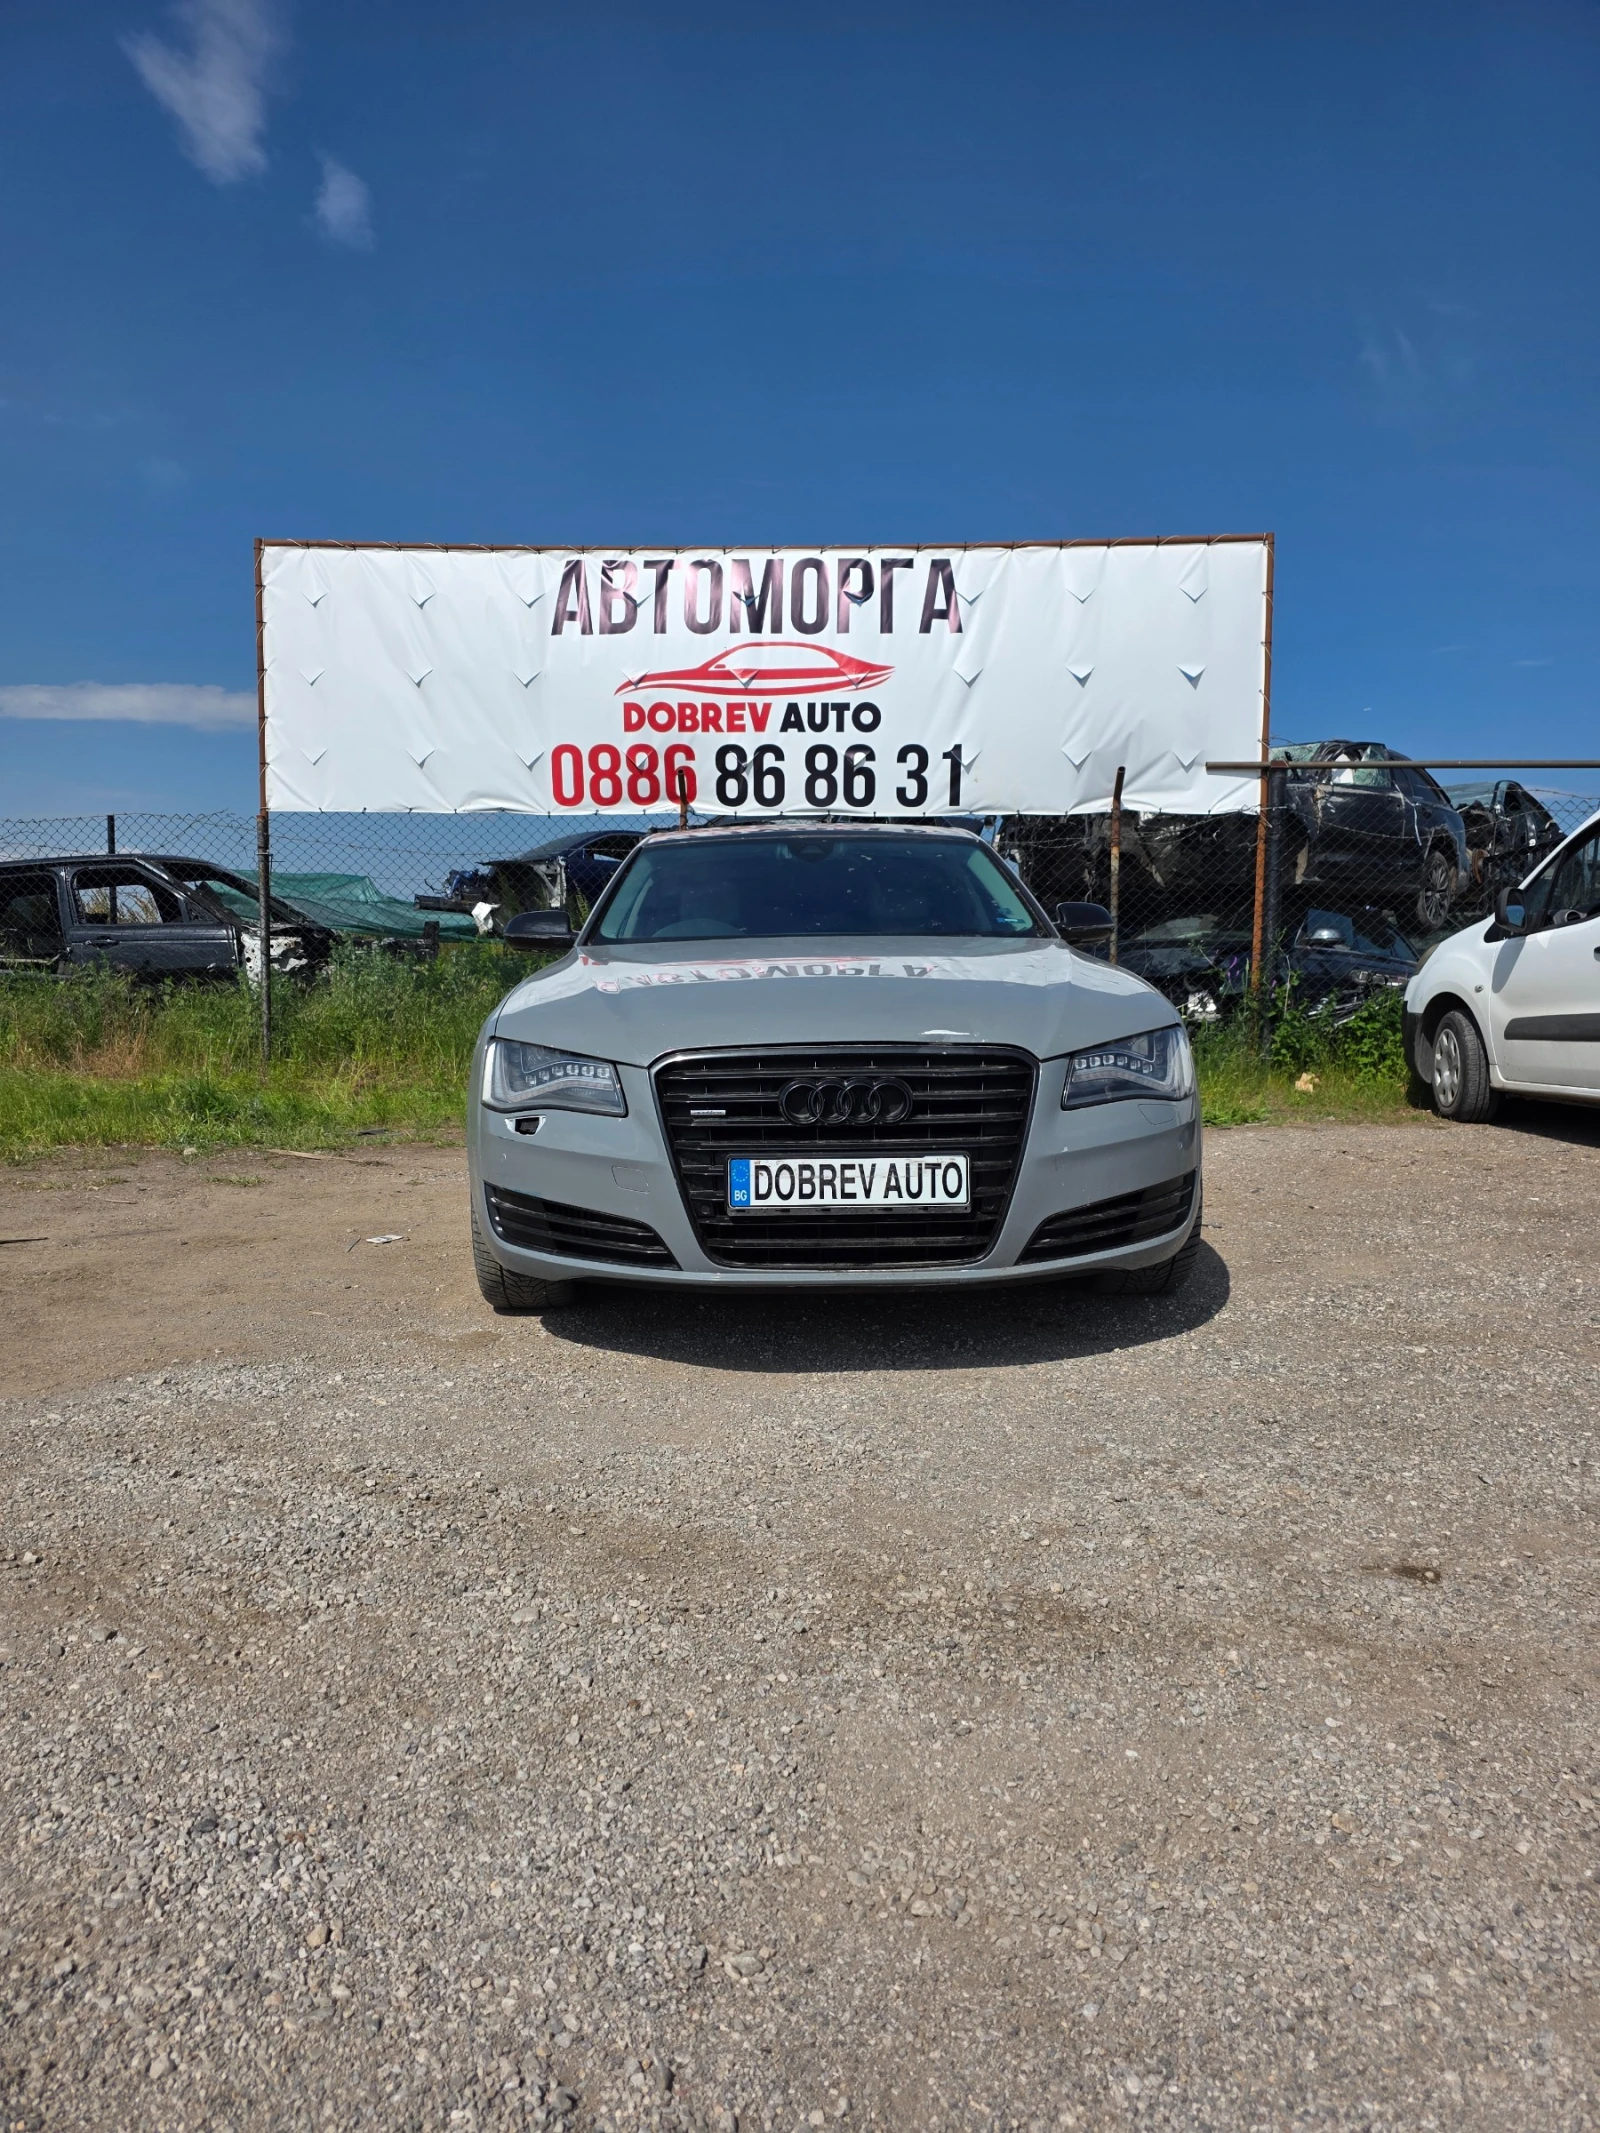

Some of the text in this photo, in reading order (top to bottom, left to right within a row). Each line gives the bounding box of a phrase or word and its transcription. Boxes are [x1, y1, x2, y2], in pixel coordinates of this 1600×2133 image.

[551, 557, 963, 636] АВТОМОРГА
[623, 702, 882, 733] DOBREV AUTO
[550, 743, 963, 807] 0886 86 86 31
[734, 1189, 748, 1201] BG
[754, 1161, 963, 1201] DOBREV AUTO
